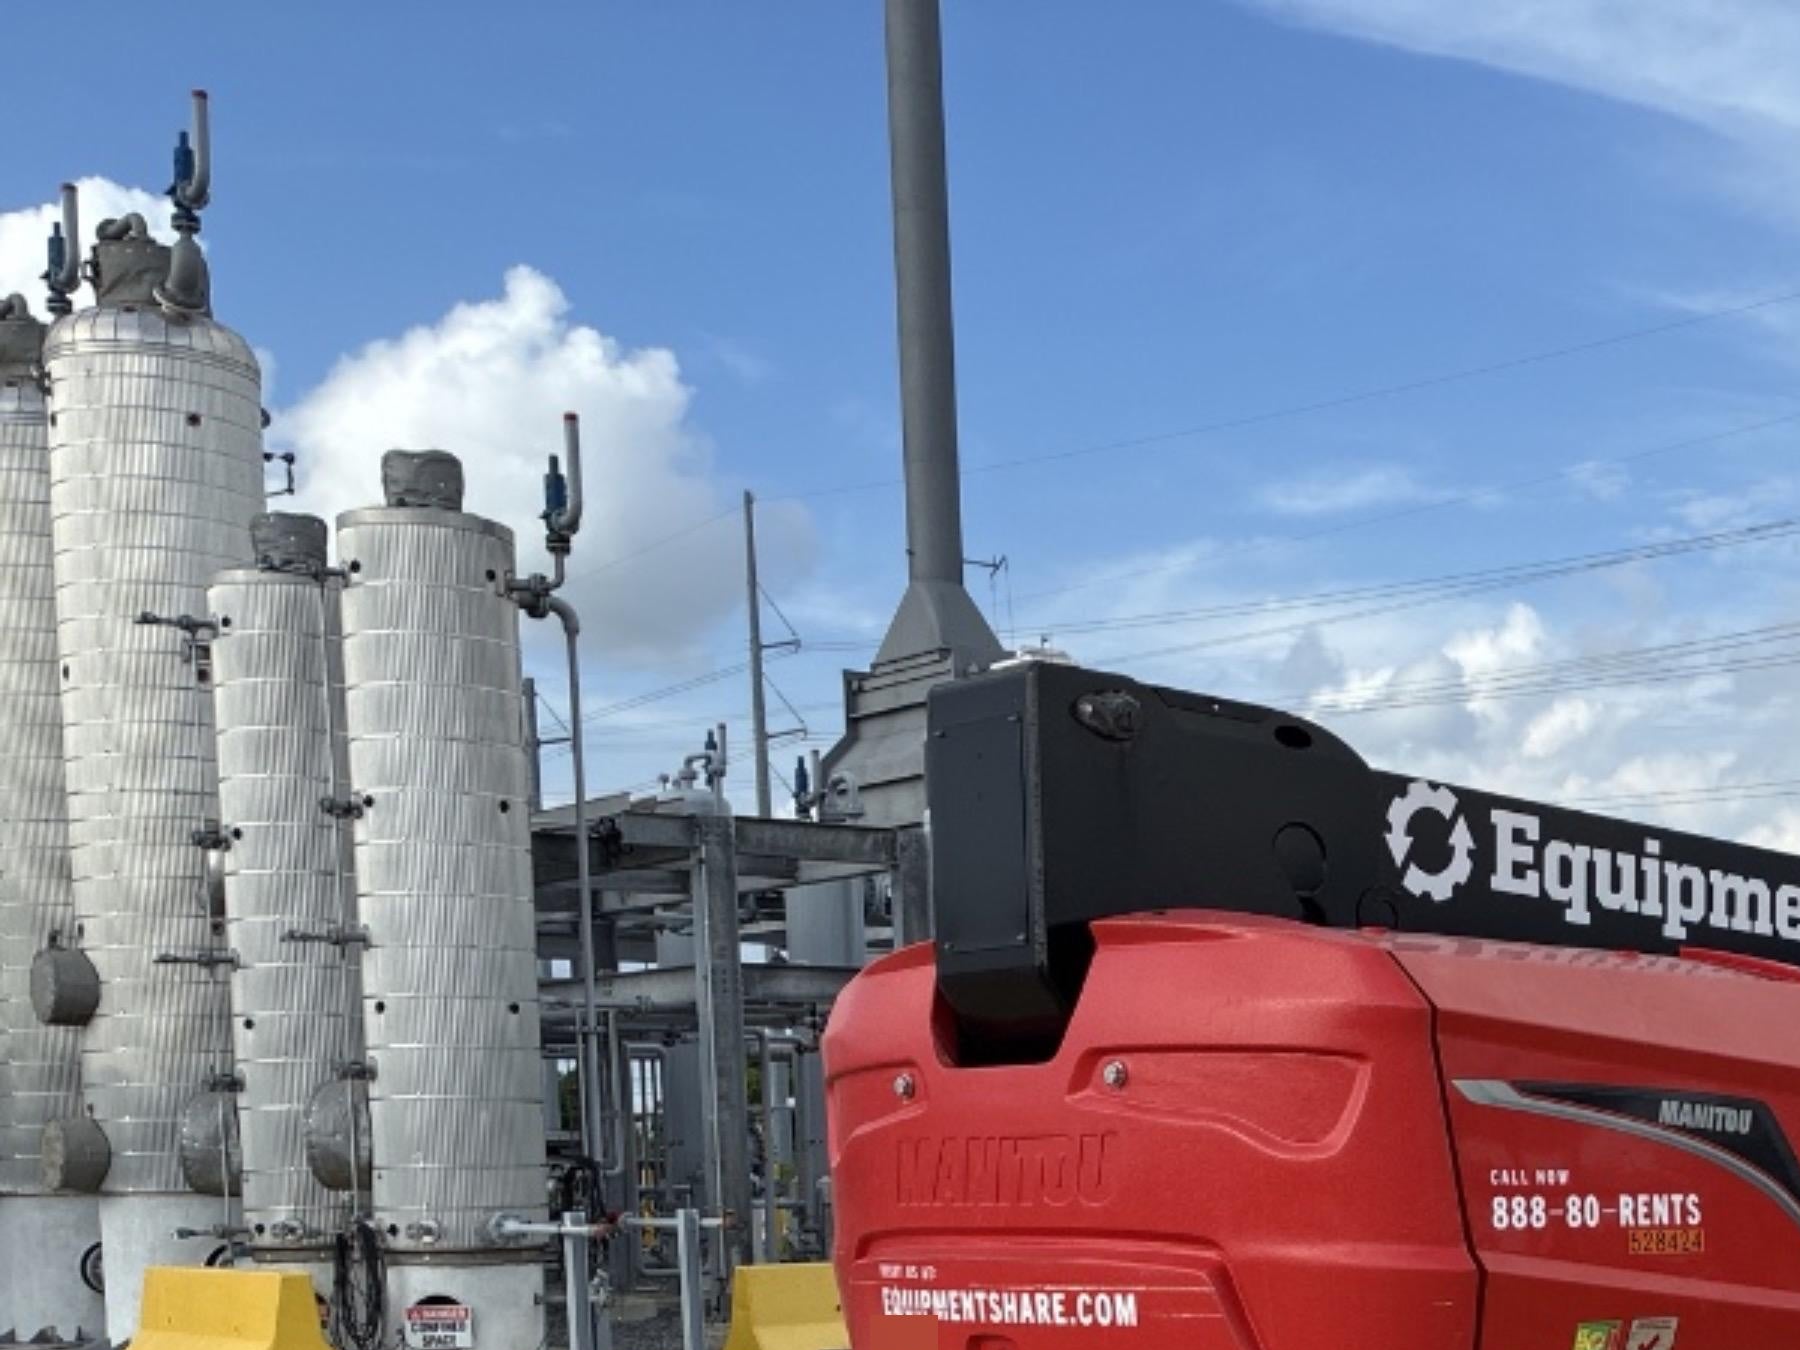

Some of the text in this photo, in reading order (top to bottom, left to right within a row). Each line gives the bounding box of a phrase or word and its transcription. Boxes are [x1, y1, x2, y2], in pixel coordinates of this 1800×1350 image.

[1658, 1099, 1753, 1135] MANITOU
[896, 1129, 1119, 1207] MANITOU
[1490, 1168, 1570, 1186] CALL NOW
[1492, 1193, 1702, 1230] 888-80-RENTS
[881, 1286, 1139, 1327] EQUIPMENTSHARE.COM
